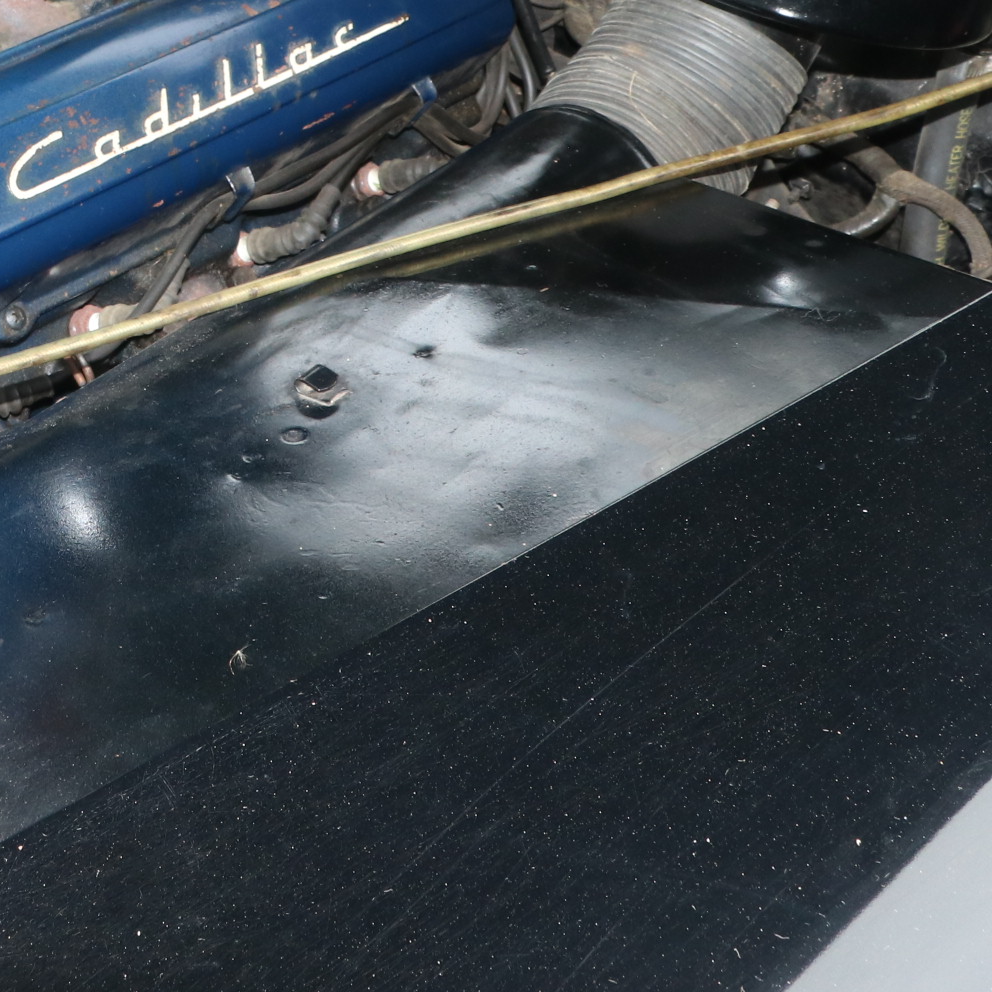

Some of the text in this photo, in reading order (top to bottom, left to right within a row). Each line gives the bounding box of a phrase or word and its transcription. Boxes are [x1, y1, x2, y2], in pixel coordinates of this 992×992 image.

[8, 13, 410, 200] Cadillac
[953, 107, 975, 139] HOSE
[944, 145, 965, 191] HEATER
